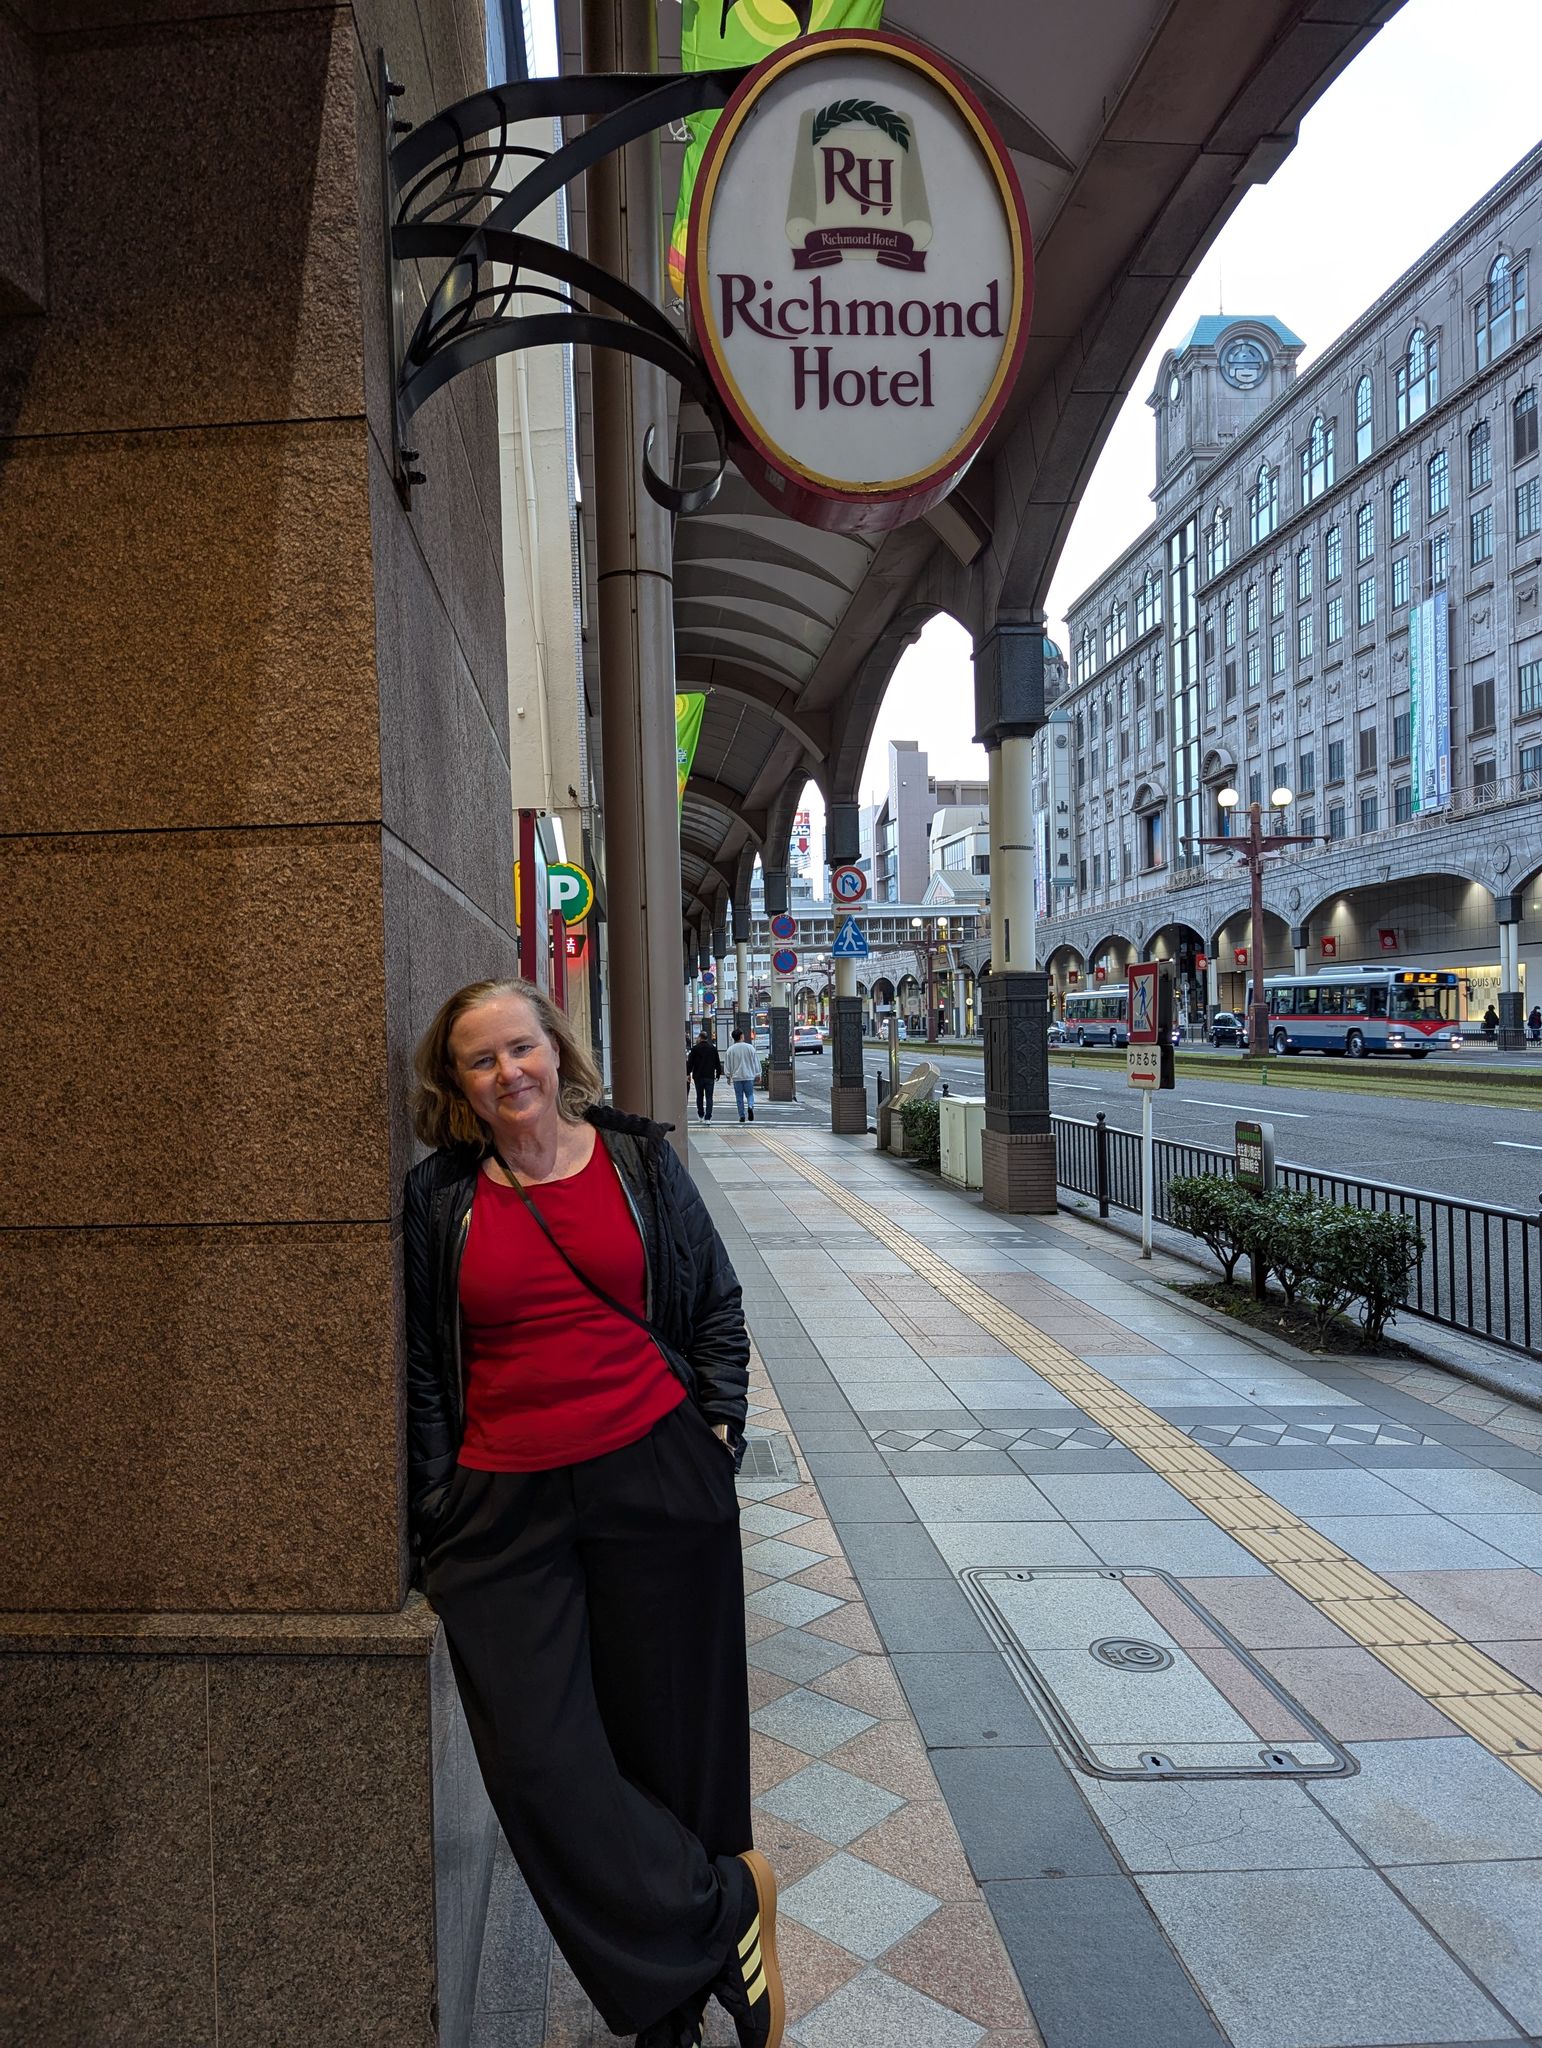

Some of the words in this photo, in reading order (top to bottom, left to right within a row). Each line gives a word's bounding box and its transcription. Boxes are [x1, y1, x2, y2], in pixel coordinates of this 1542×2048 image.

[820, 146, 894, 216] RH
[821, 232, 871, 246] Richmond
[872, 233, 898, 247] Hotel
[716, 273, 1004, 340] Richmond
[788, 346, 935, 411] Hotel
[549, 874, 580, 910] P
[1468, 977, 1489, 988] LOUIS
[1129, 1052, 1158, 1066] わたるな
